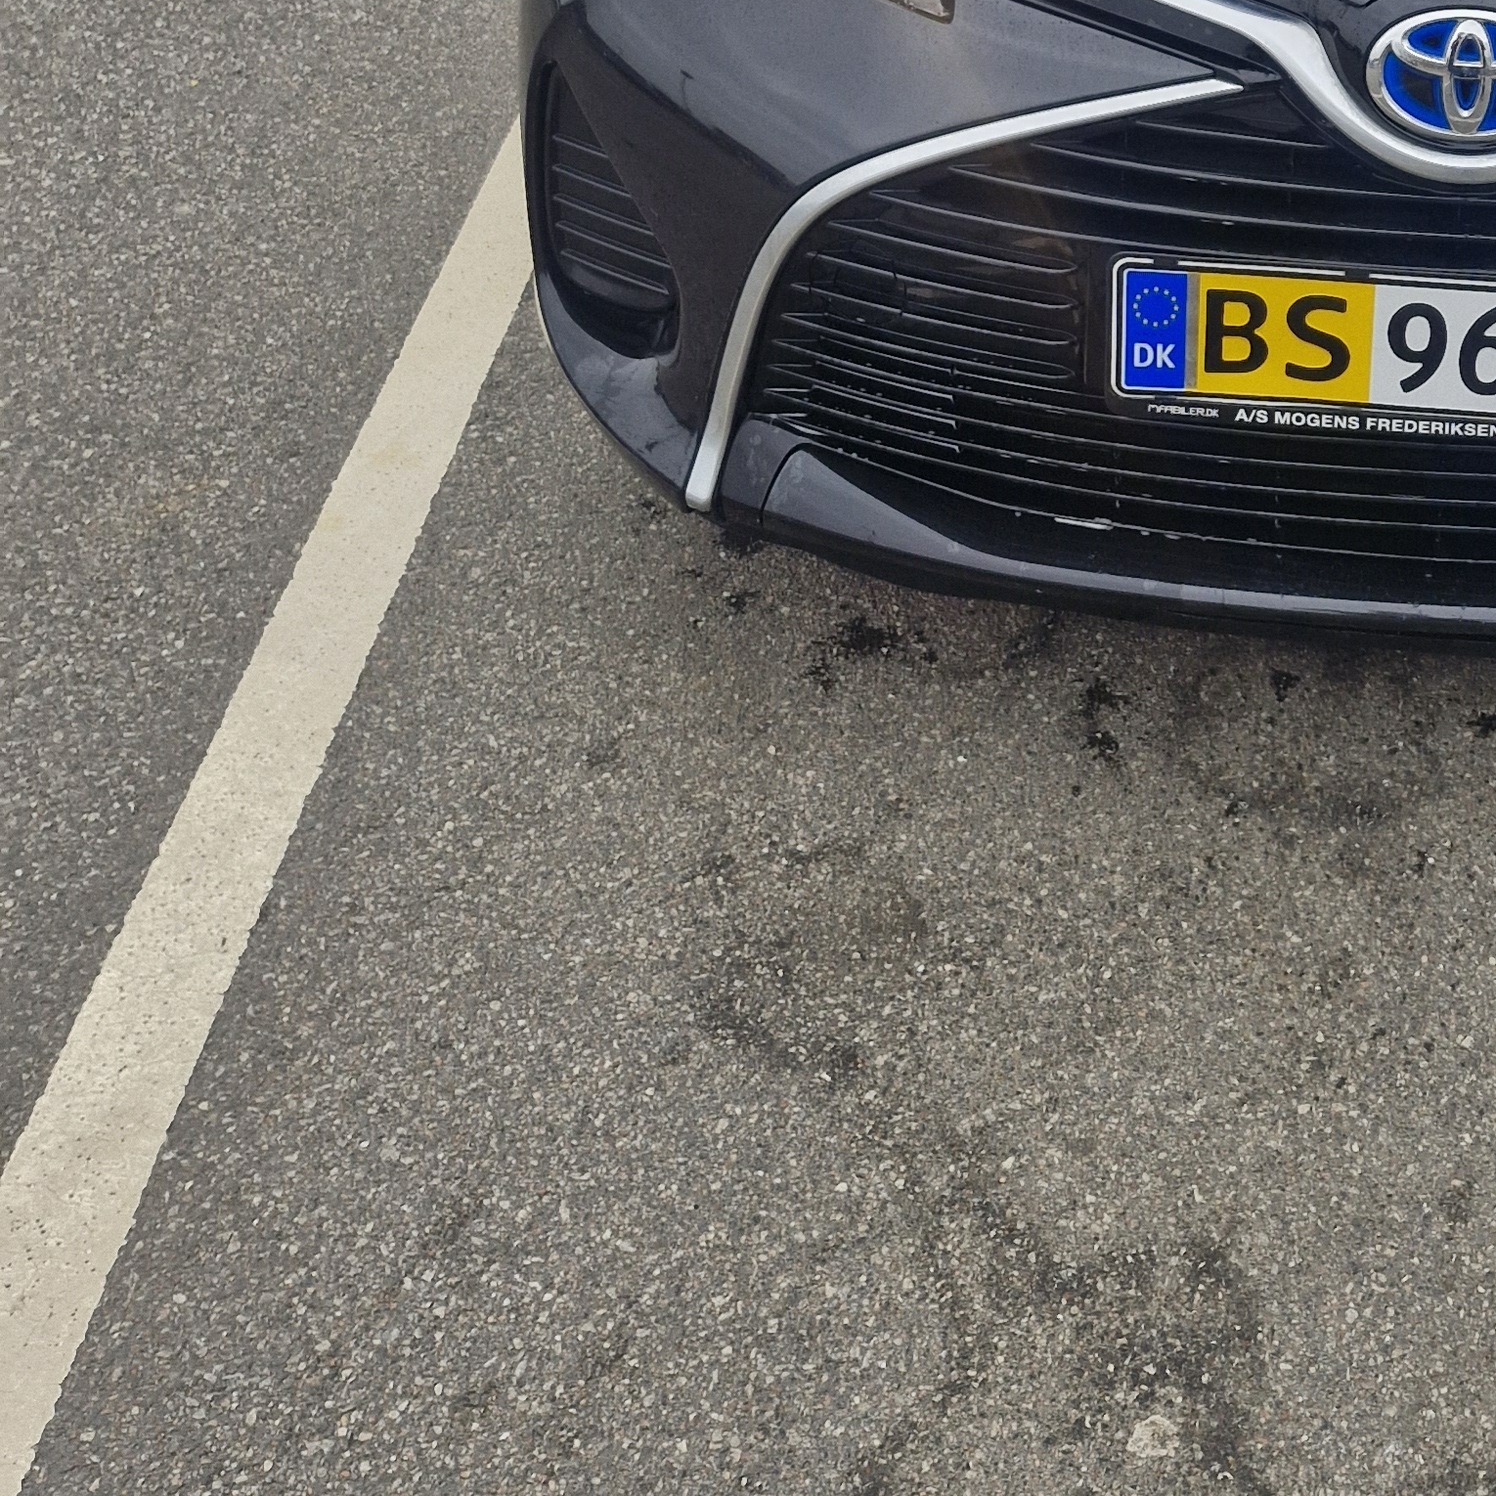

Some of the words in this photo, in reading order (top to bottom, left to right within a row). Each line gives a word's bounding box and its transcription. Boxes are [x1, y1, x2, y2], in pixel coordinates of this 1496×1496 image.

[1204, 288, 1351, 383] BS
[1133, 342, 1176, 369] DK
[1234, 408, 1269, 424] A/S
[1274, 411, 1360, 430] MOGENS
